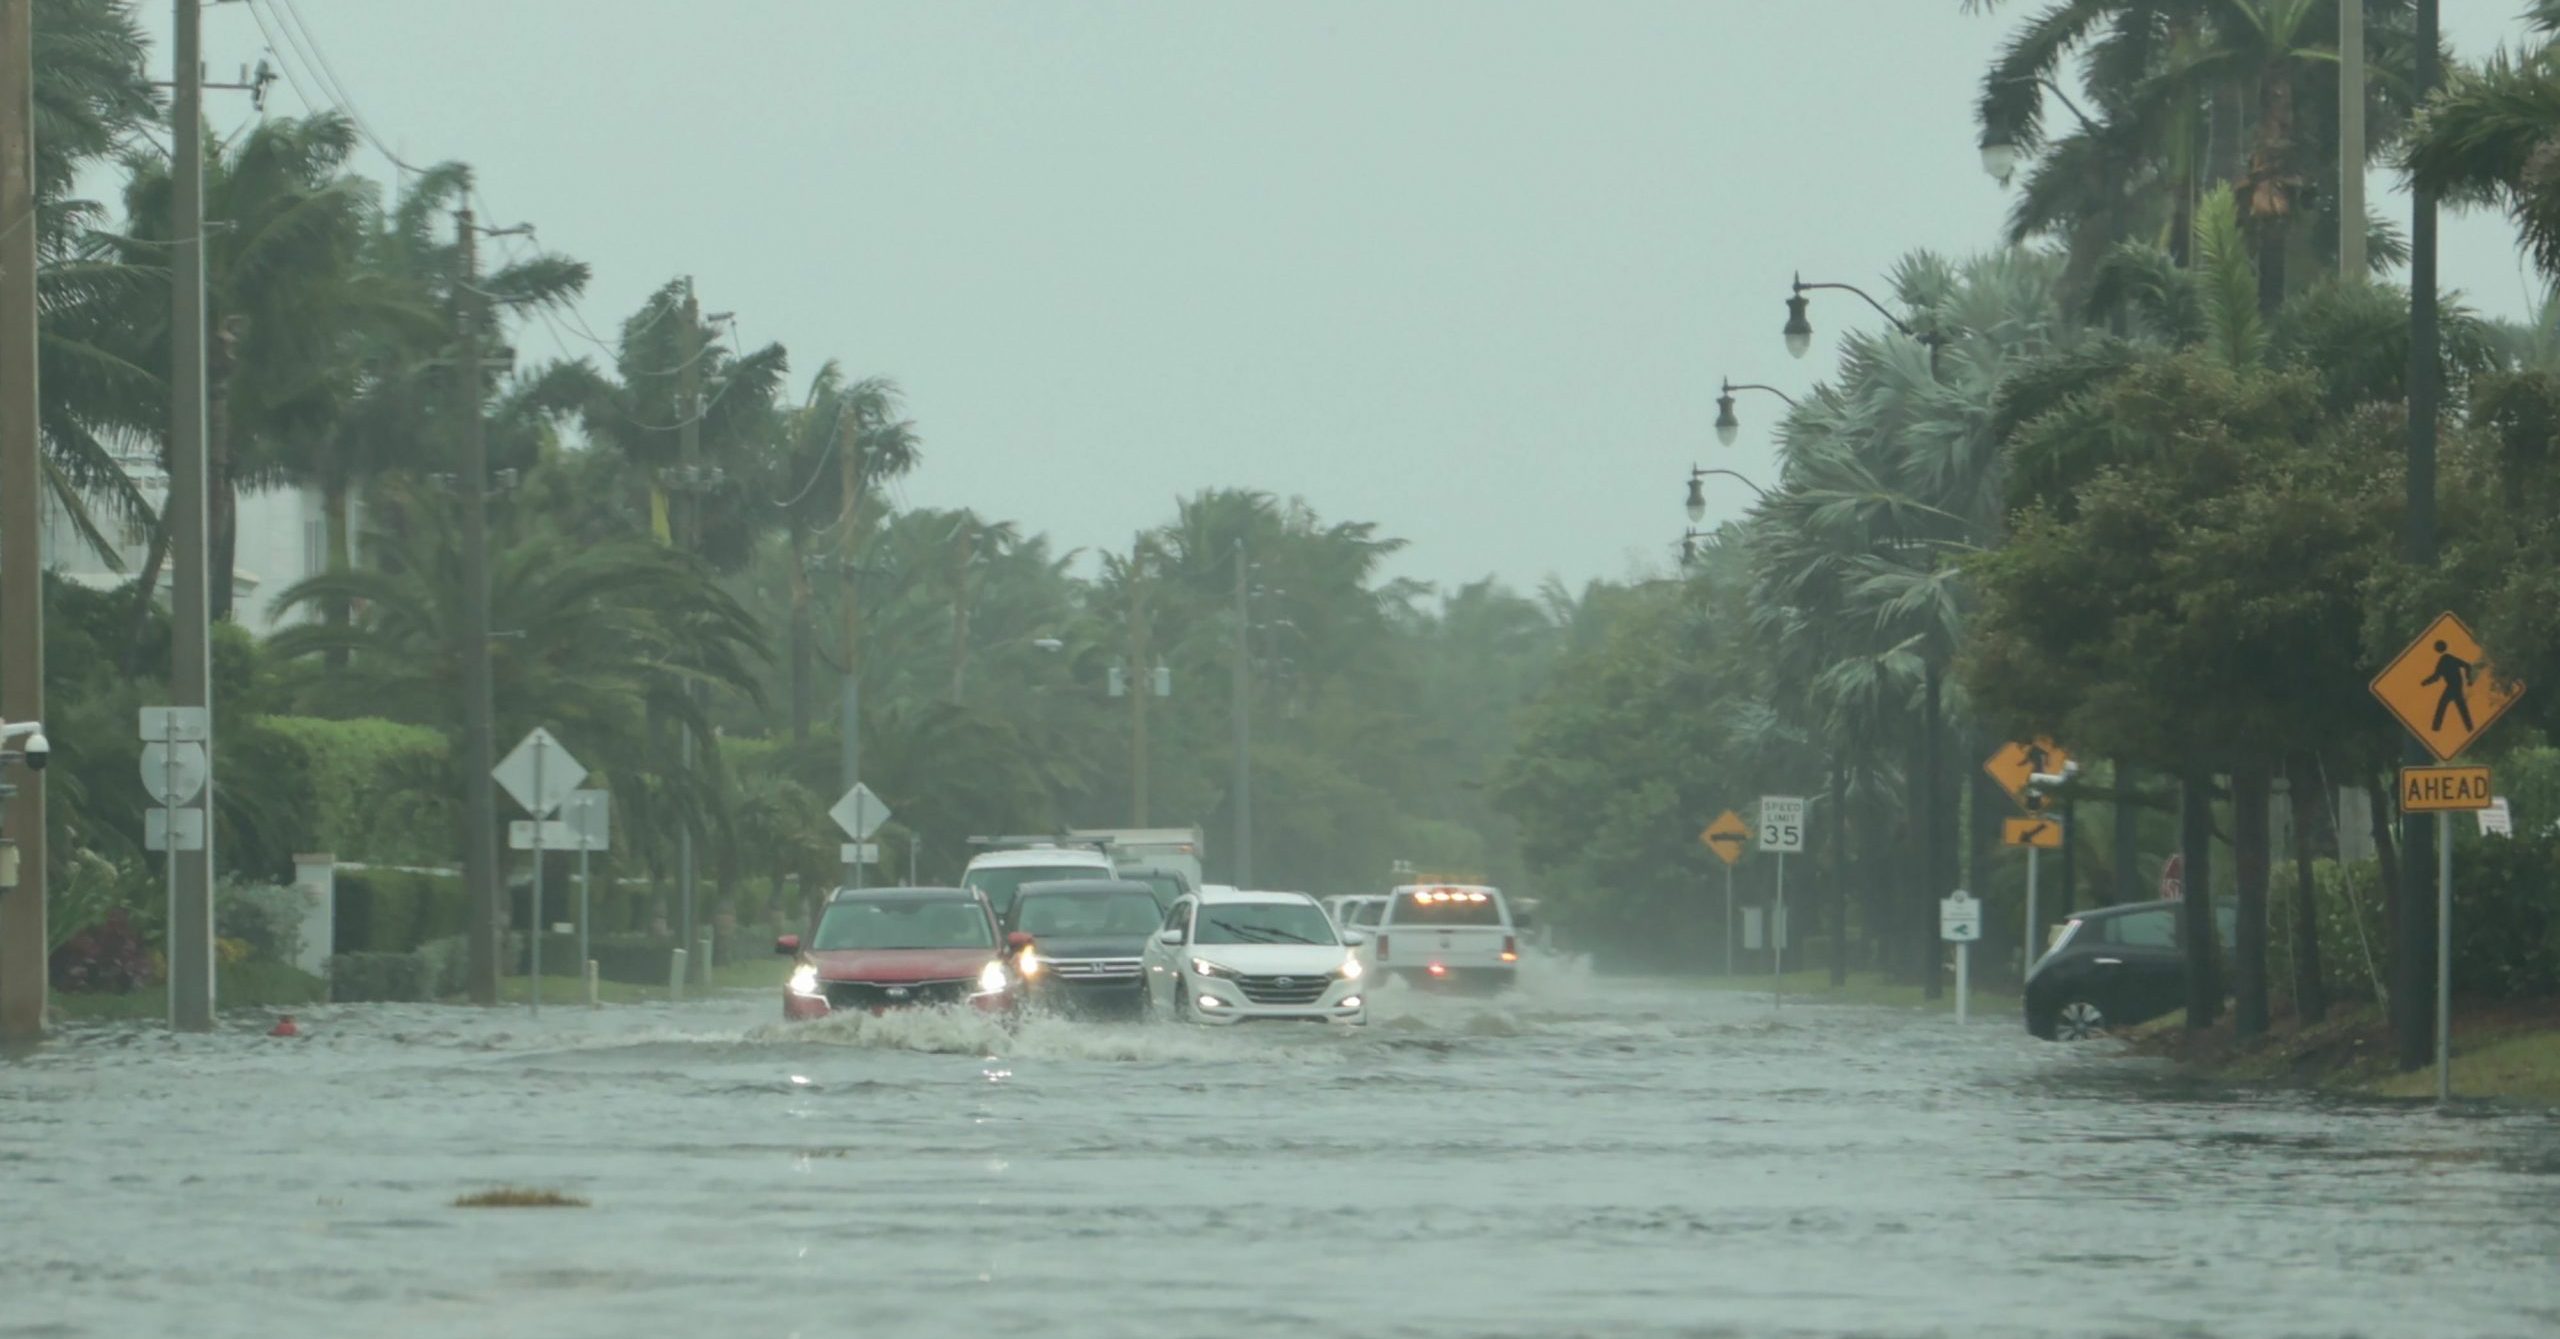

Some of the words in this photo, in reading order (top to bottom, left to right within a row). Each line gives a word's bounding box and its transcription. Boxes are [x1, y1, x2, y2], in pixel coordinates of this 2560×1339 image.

[2408, 776, 2487, 801] AHEAD
[1764, 802, 1801, 811] SPEED
[1767, 813, 1796, 822] LIMIT
[1764, 825, 1799, 845] 35
